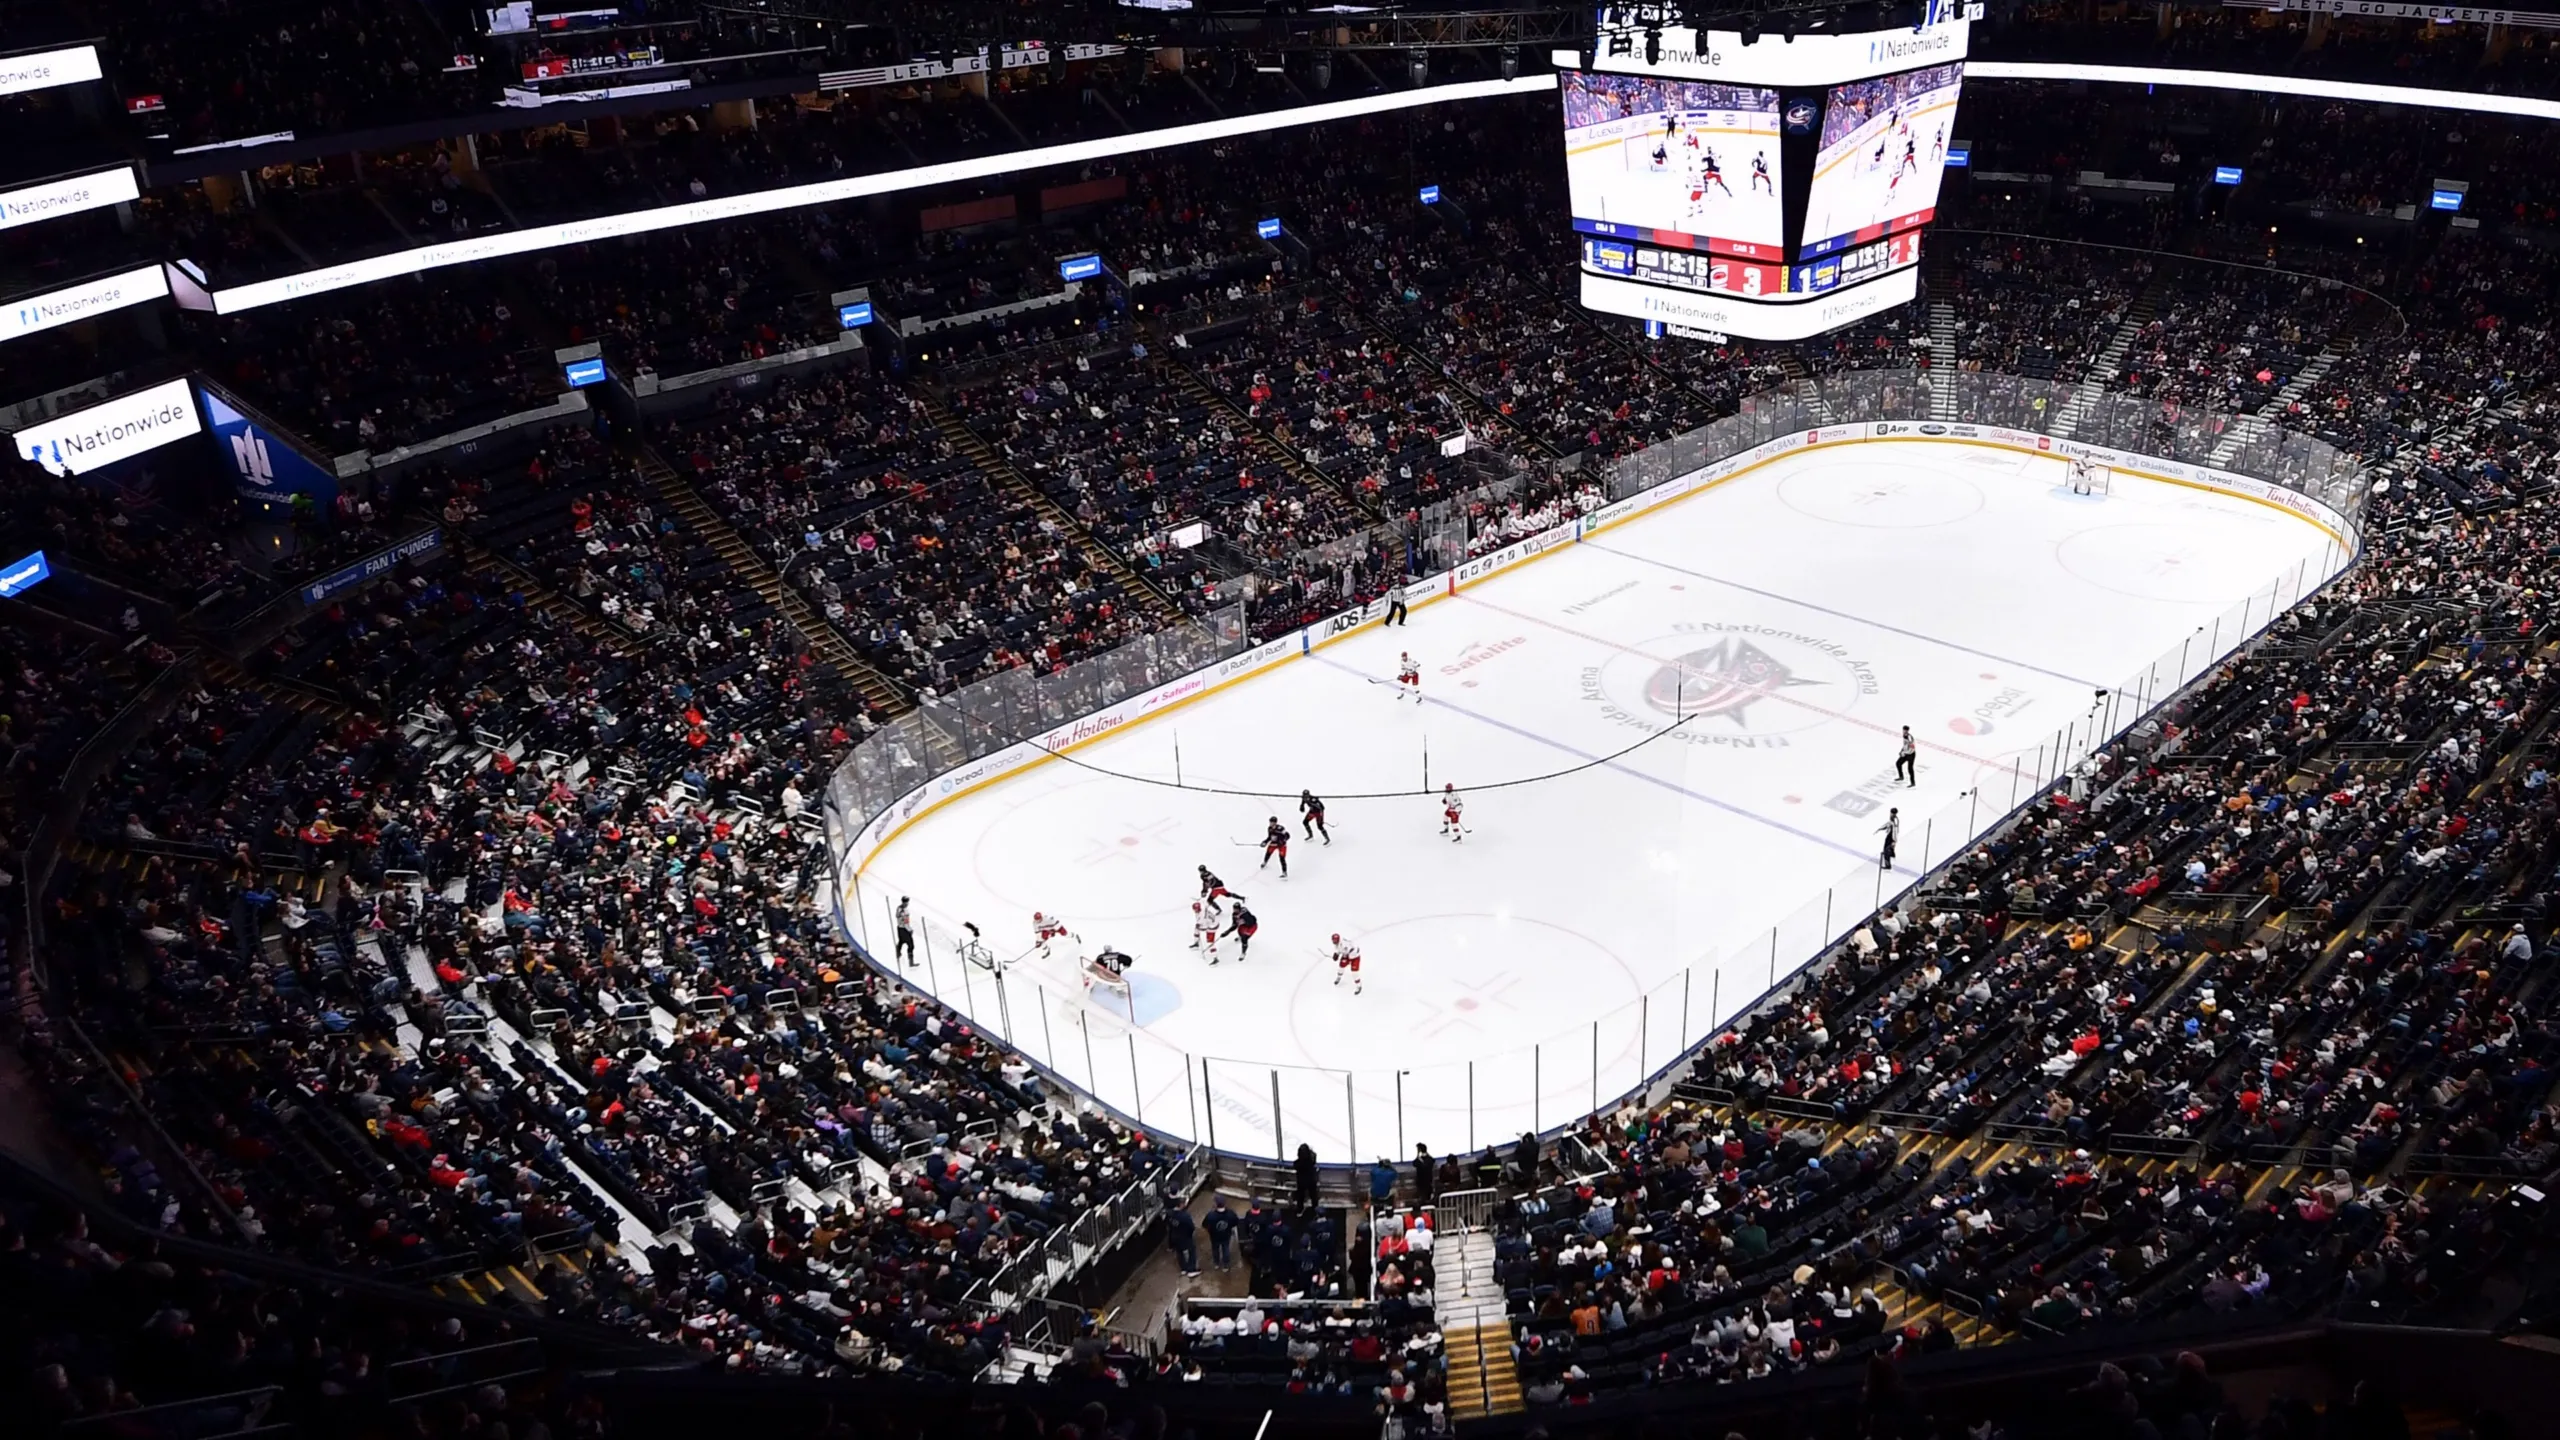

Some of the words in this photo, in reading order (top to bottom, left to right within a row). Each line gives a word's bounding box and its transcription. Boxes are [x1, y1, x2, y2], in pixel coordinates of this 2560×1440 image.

[2359, 3, 2386, 15] GO
[2397, 7, 2506, 22] JACKETS
[1008, 44, 1104, 66] JACETS
[1886, 34, 1949, 59] Nationwide
[0, 65, 51, 85] onwide
[8, 188, 91, 217] Nationwide
[1661, 250, 1708, 277] 13:15
[1742, 266, 1762, 297] 3
[42, 288, 121, 319] Nationwide
[1660, 299, 1728, 324] Nationwide
[1666, 323, 1728, 346] Nationwide
[64, 403, 185, 457] Nationwide
[461, 441, 478, 455] 101
[2140, 460, 2184, 476] OhioHealth
[2208, 473, 2233, 486] bread
[2266, 485, 2285, 504] Tim
[2285, 493, 2321, 520] Hortons
[365, 555, 389, 575] FAN
[1416, 583, 1436, 596] PIZZA
[1332, 611, 1360, 635] ADS
[1439, 634, 1527, 676] Safelite
[1702, 622, 1848, 657] Nationwide
[1846, 659, 1879, 695] Arena
[1581, 666, 1606, 702] Arena
[1974, 687, 2028, 719] pepsi
[1044, 730, 1070, 752] Tim
[1071, 712, 1125, 743] Hortons
[954, 767, 984, 785] bread
[984, 750, 1024, 773] financial
